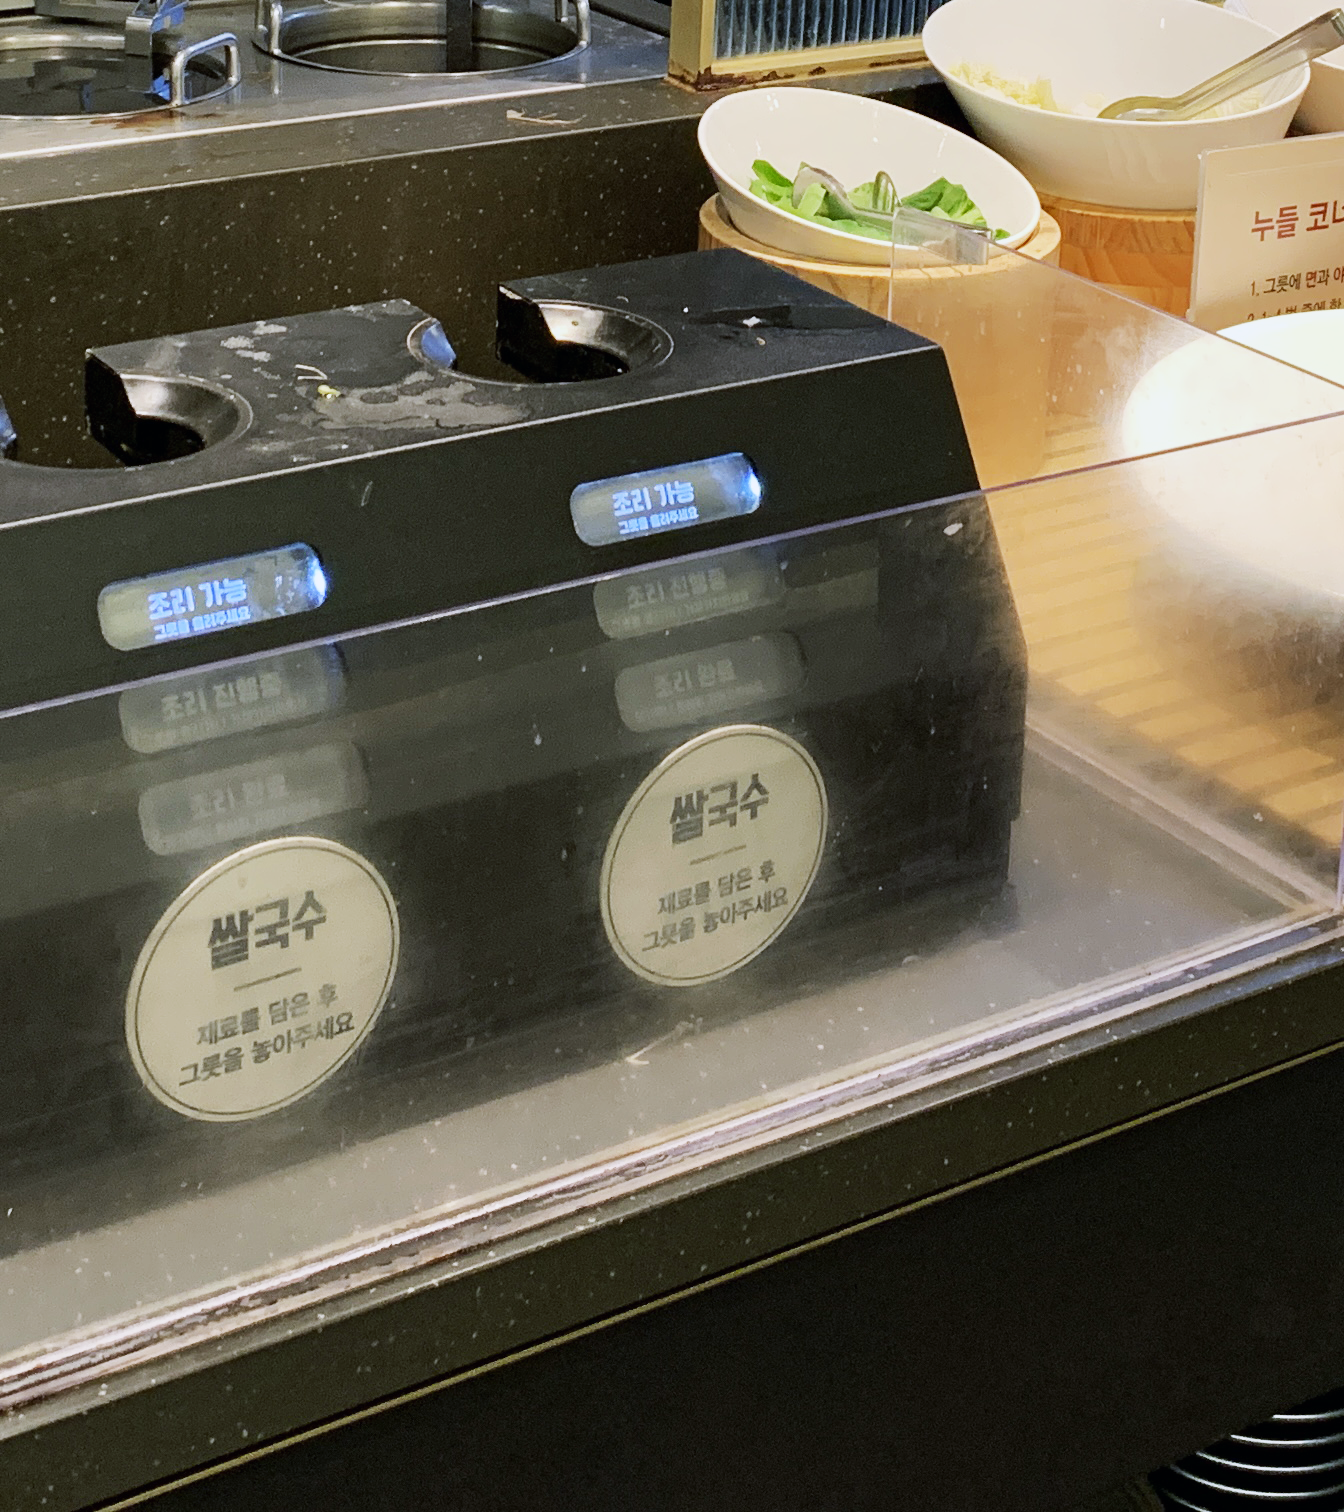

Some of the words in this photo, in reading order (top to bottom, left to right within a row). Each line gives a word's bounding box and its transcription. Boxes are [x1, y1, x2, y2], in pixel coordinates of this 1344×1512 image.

[1251, 205, 1299, 242] 누들
[1263, 273, 1302, 294] 그릇에
[1305, 268, 1330, 289] 면과
[612, 487, 652, 517] 조리
[653, 480, 695, 507] 가능
[147, 585, 196, 621] 조리
[197, 578, 248, 608] 가능
[669, 772, 771, 846] 쌀국수
[657, 880, 712, 916] 재료를
[718, 867, 754, 898] 담은
[757, 858, 777, 884] 후
[207, 889, 328, 970] 쌀국수
[641, 916, 697, 952] 그릇을
[703, 886, 790, 934] 놓아주세요
[196, 1006, 262, 1046] 재료를
[268, 991, 311, 1026] 담은
[318, 982, 339, 1008] 후
[178, 1046, 244, 1087] 그릇을
[251, 1011, 356, 1065] 놓아주세요
